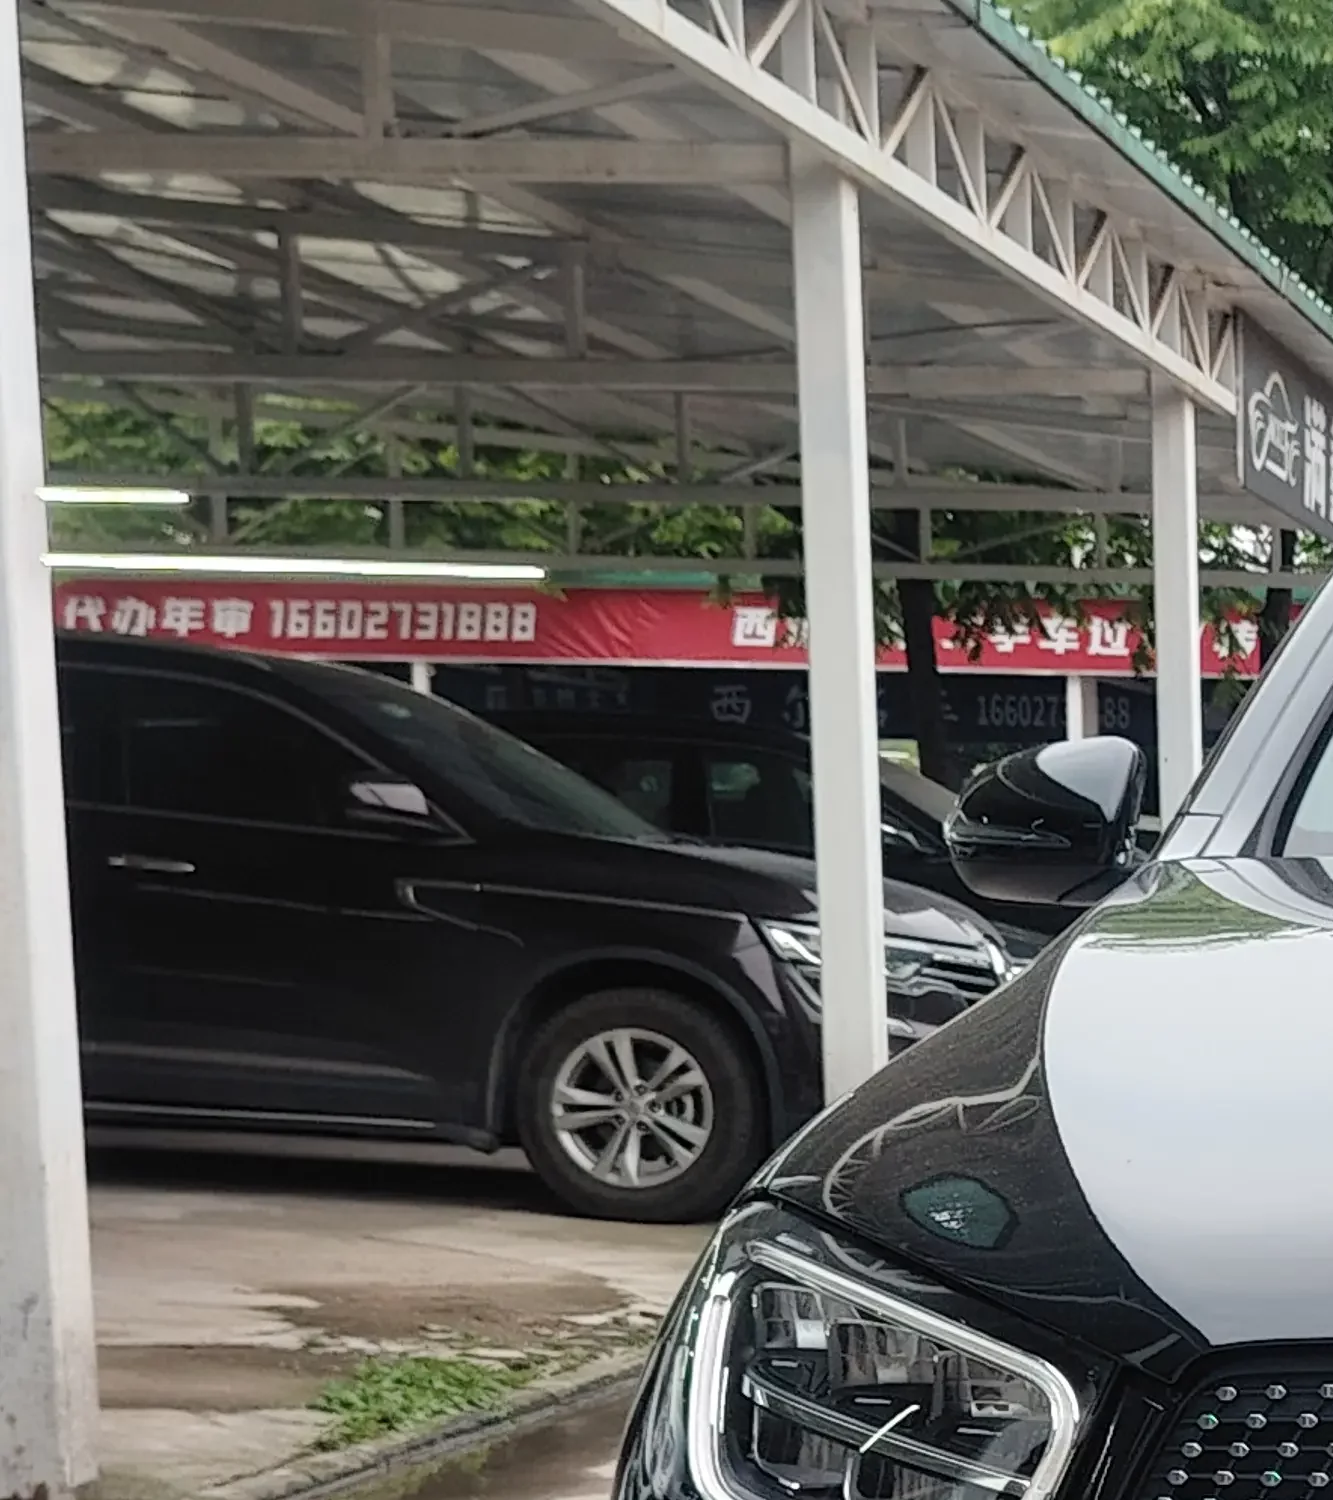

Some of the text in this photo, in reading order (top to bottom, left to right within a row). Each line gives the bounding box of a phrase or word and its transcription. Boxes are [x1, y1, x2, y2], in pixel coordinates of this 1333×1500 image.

[64, 596, 537, 642] 代办年审 16602731888
[976, 694, 1132, 731] 16602788
